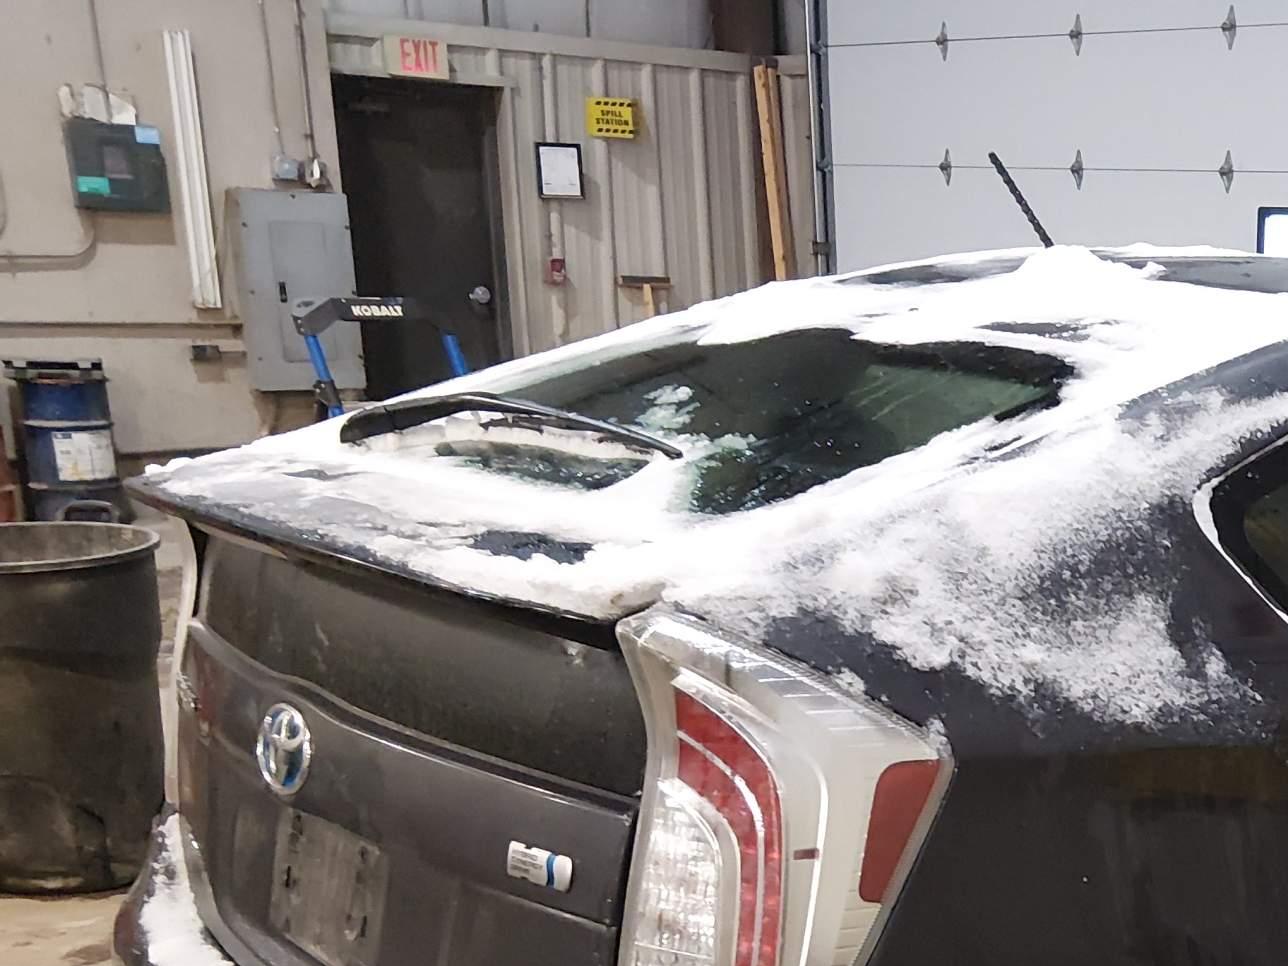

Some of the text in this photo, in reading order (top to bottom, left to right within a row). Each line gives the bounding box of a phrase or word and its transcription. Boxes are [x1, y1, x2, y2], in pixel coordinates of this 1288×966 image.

[400, 38, 438, 72] EXIT
[601, 110, 623, 118] SPILL
[595, 118, 630, 126] STATION
[350, 305, 404, 317] KOBALT
